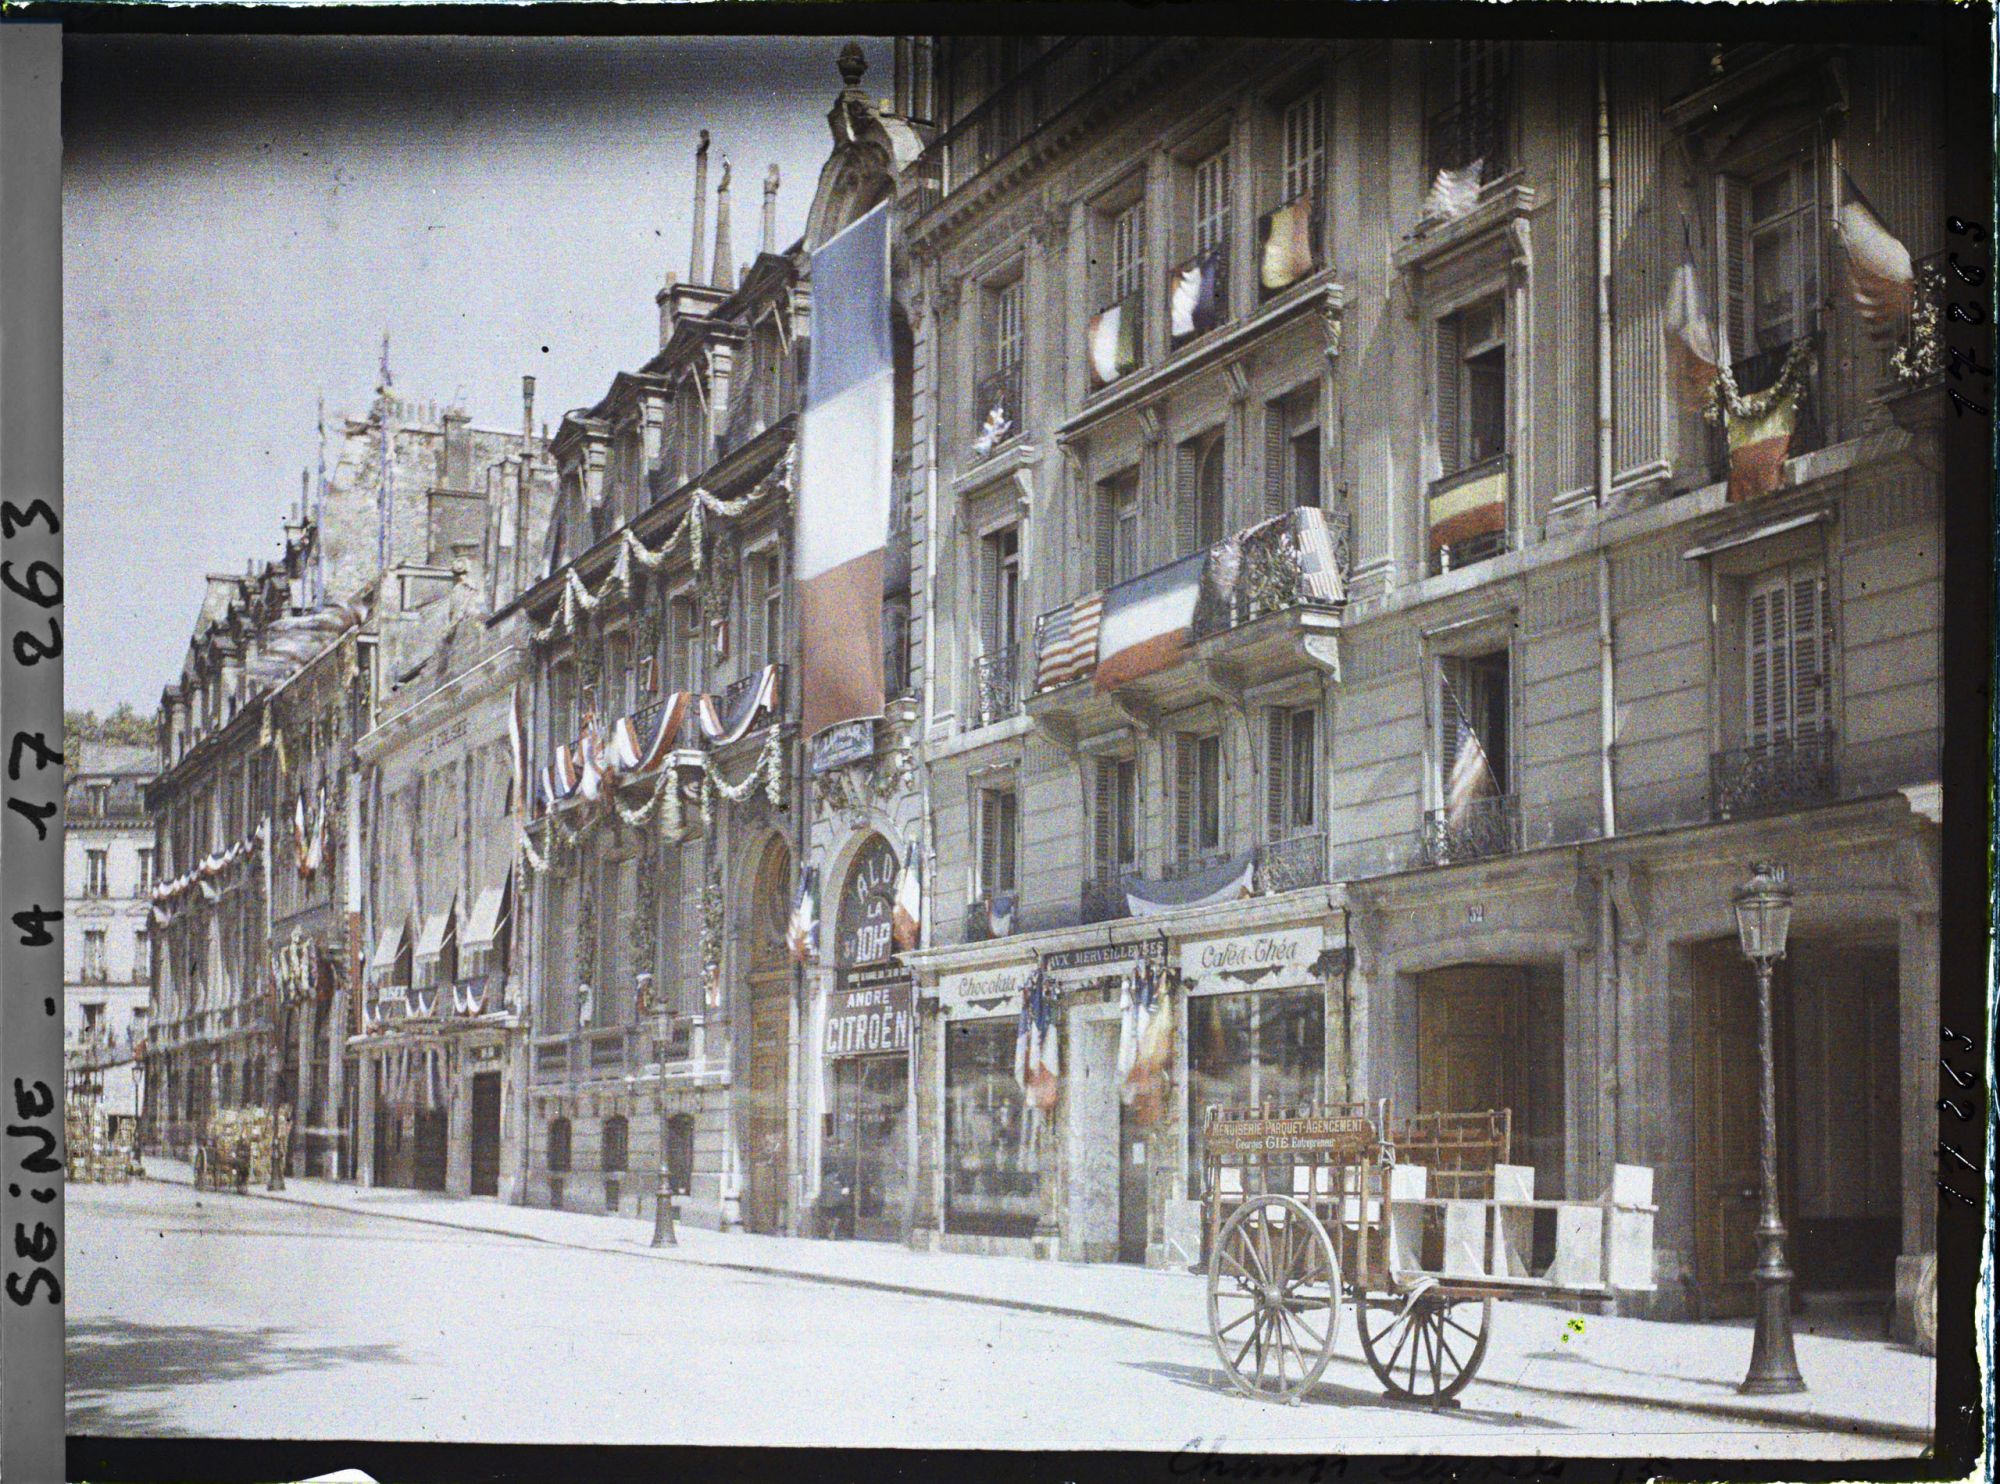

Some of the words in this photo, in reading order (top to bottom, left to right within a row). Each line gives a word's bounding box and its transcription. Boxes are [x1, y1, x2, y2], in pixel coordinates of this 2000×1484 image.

[867, 901, 883, 918] LA
[826, 1005, 907, 1053] CITROËN
[1212, 1121, 1262, 1136] MENUISERIE
